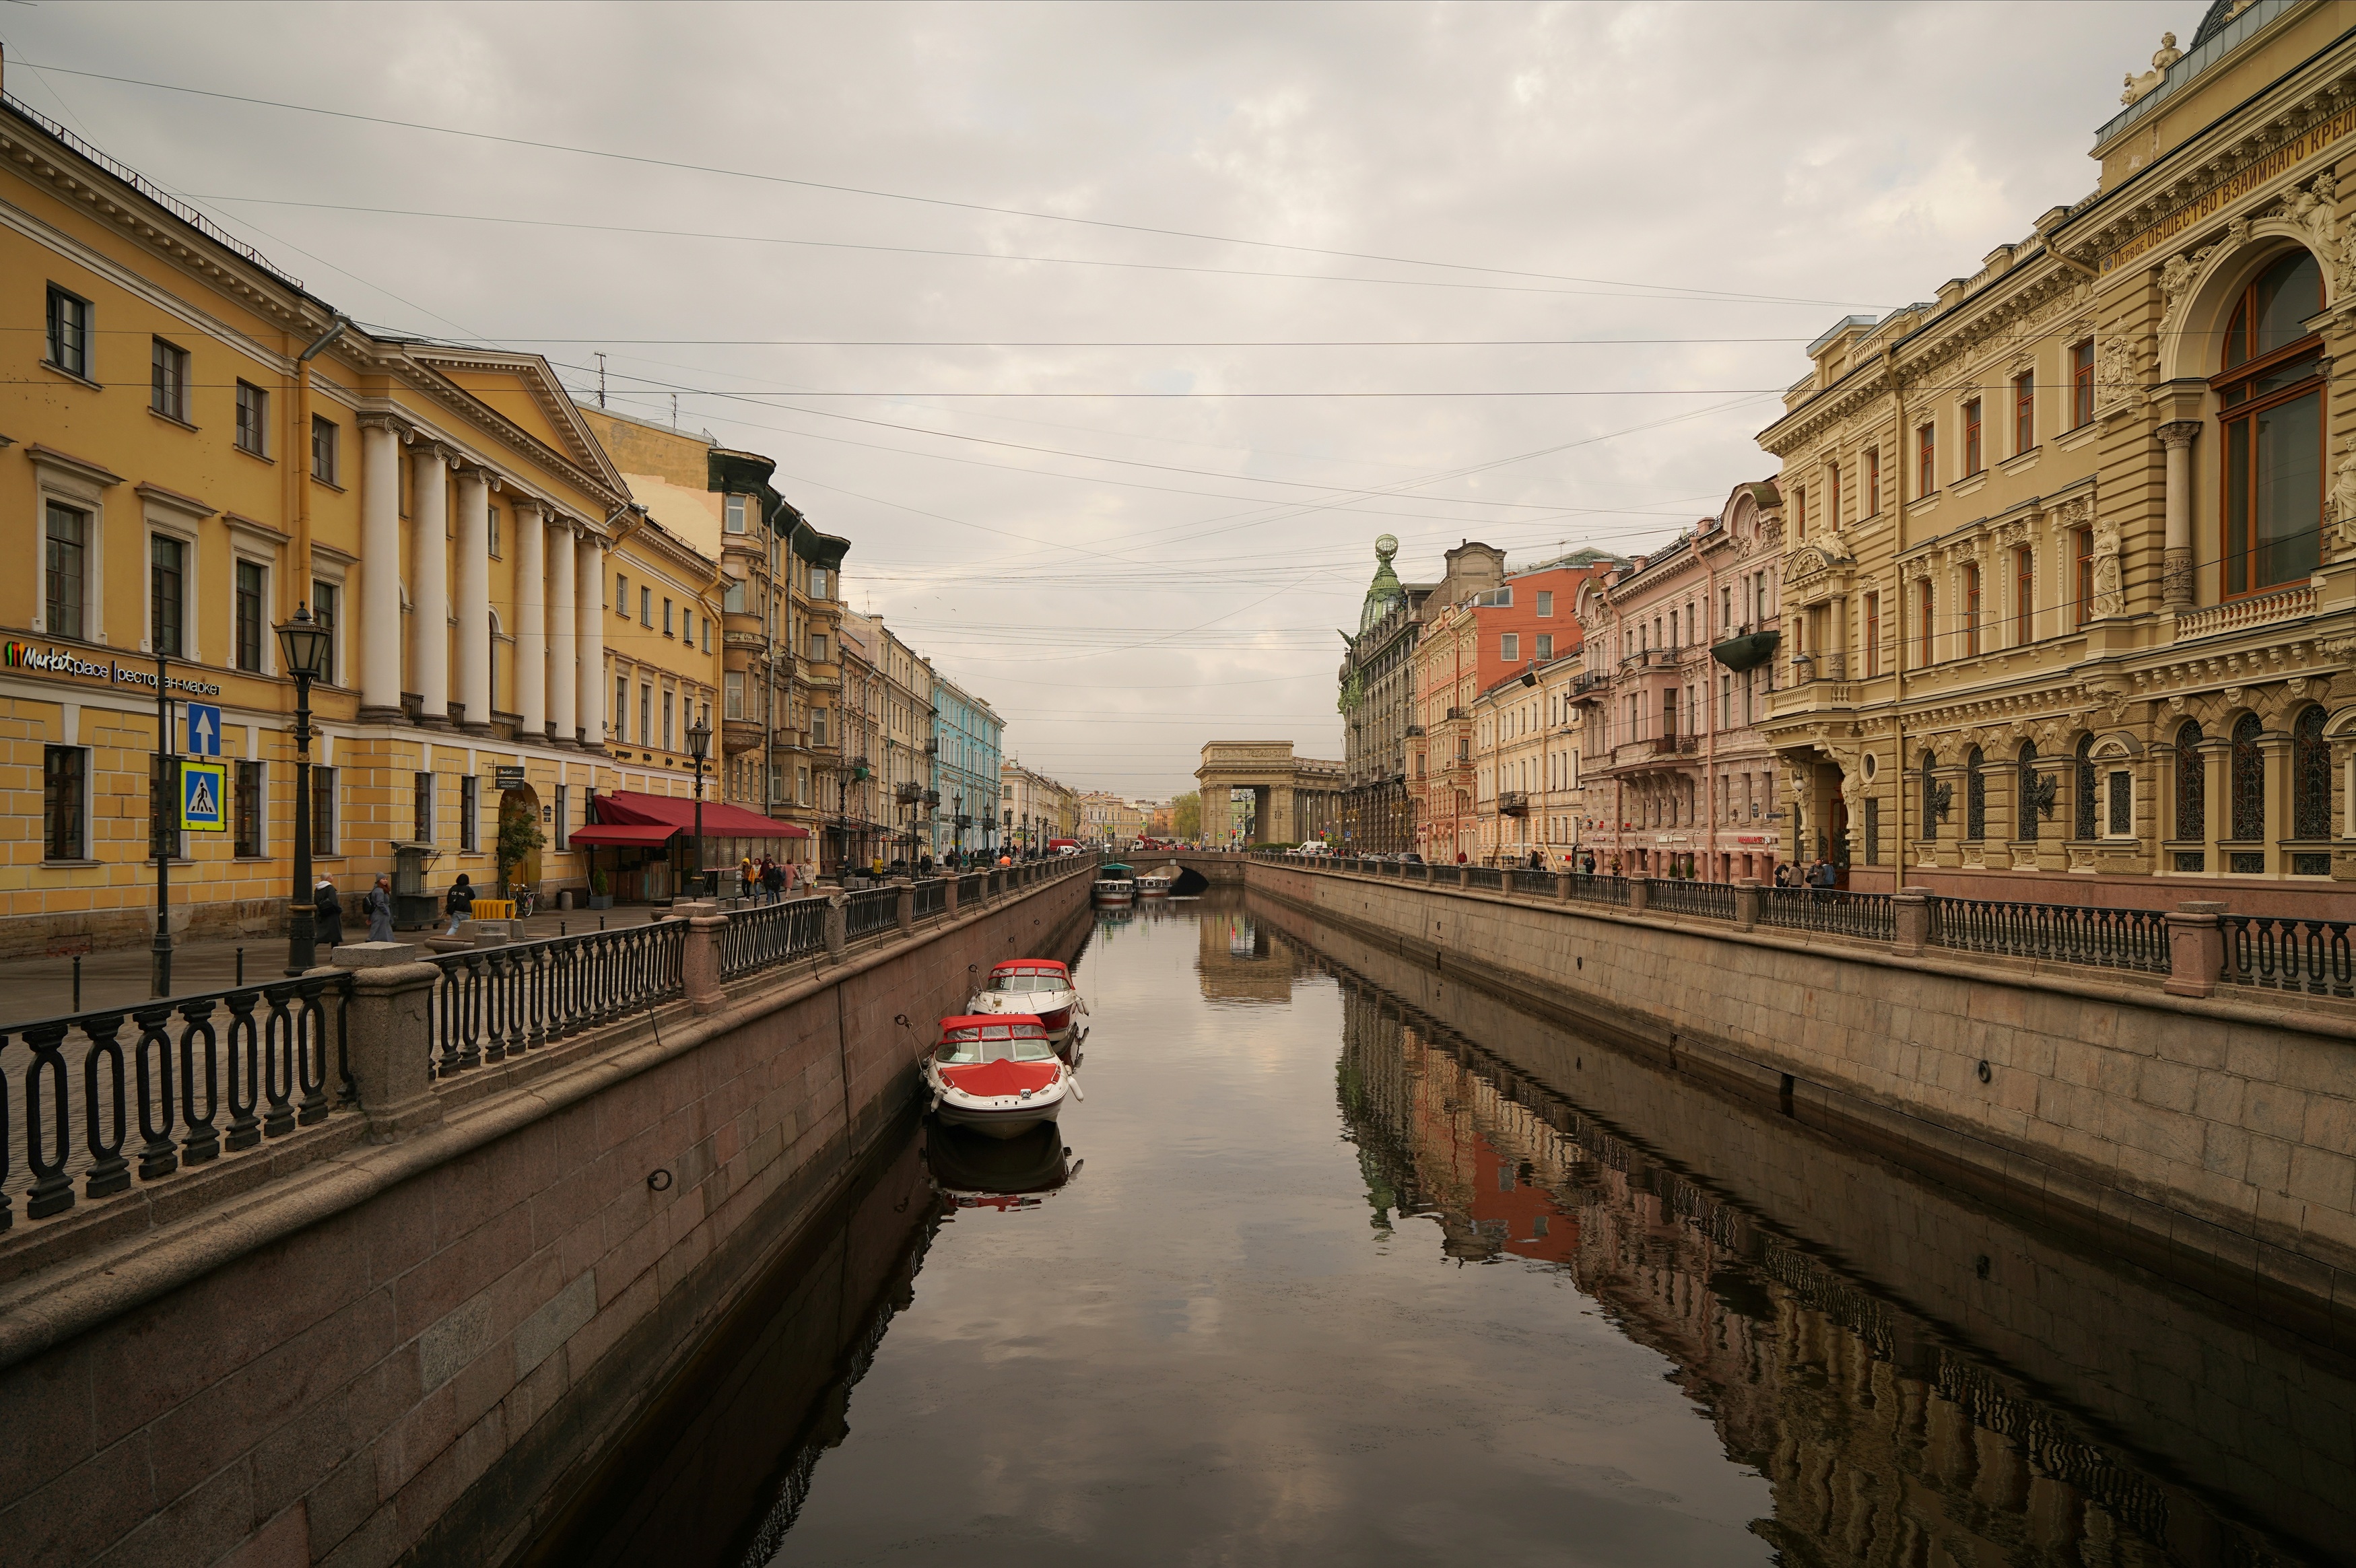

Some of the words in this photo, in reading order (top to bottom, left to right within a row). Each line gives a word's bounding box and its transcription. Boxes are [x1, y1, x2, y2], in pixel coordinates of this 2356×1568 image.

[2147, 191, 2217, 248] ОБЩЕСТВО
[2222, 139, 2304, 205] ВЗАИМНАГО
[2311, 106, 2356, 154] КРЕД
